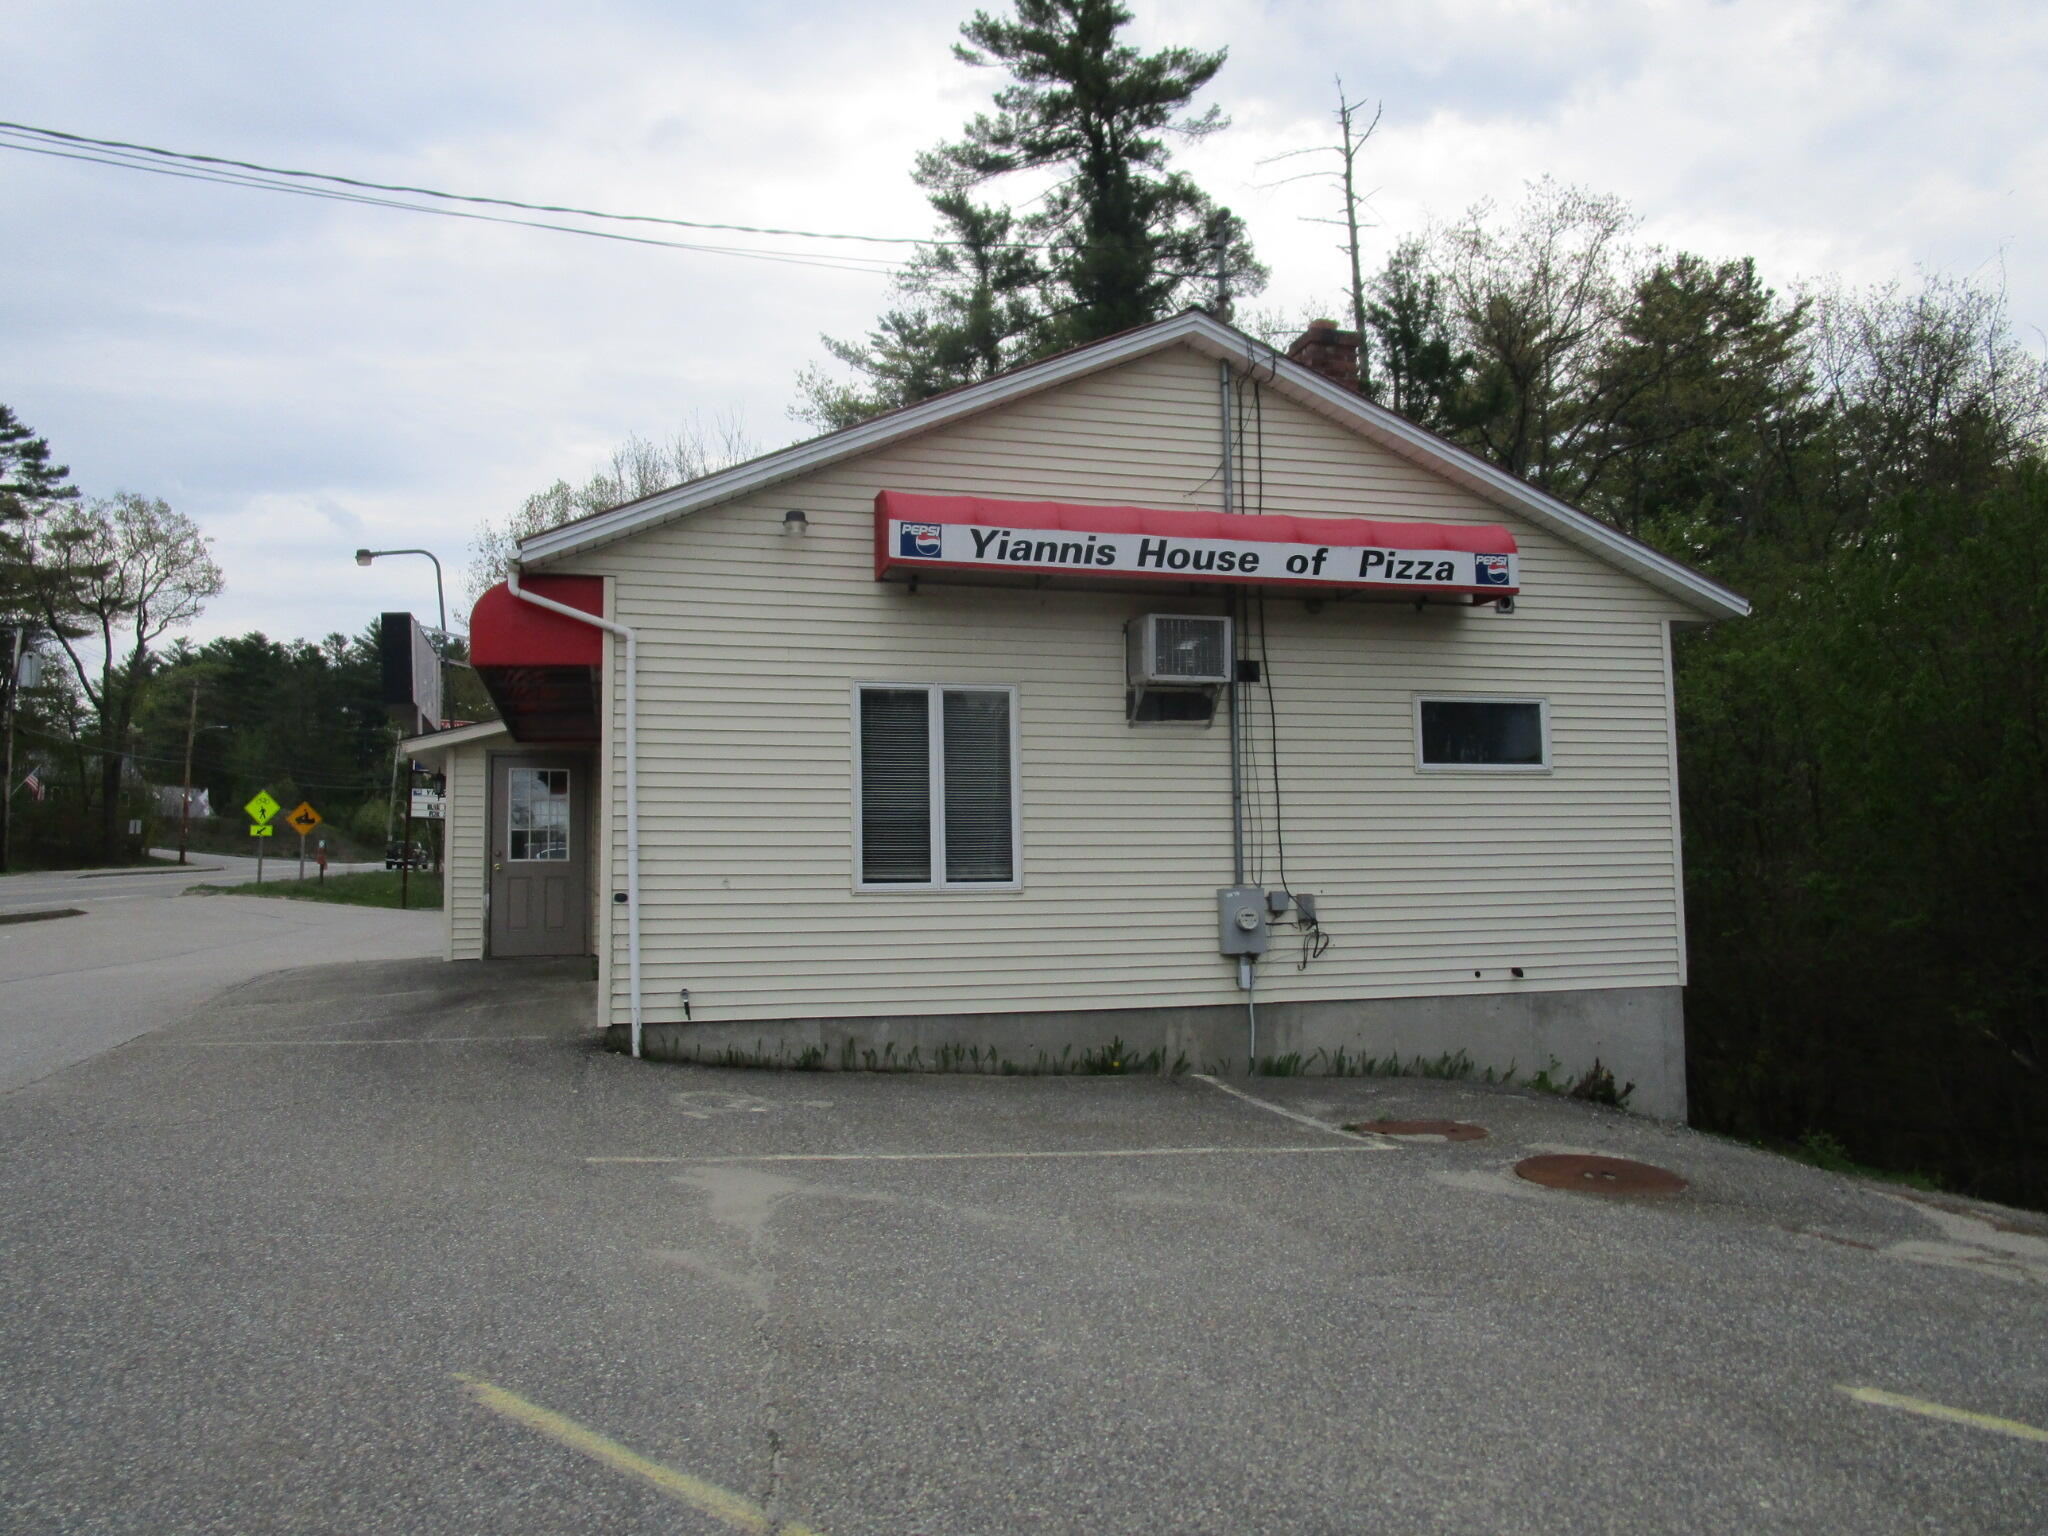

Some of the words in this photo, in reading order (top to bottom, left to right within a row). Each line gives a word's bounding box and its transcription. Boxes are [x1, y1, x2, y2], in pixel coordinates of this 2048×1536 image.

[901, 523, 940, 537] PEPSI
[970, 528, 1117, 566] Yiannis
[1137, 538, 1260, 573] House
[1286, 547, 1329, 576] of
[1358, 549, 1455, 581] Pizza
[1475, 555, 1507, 567] PEPSI
